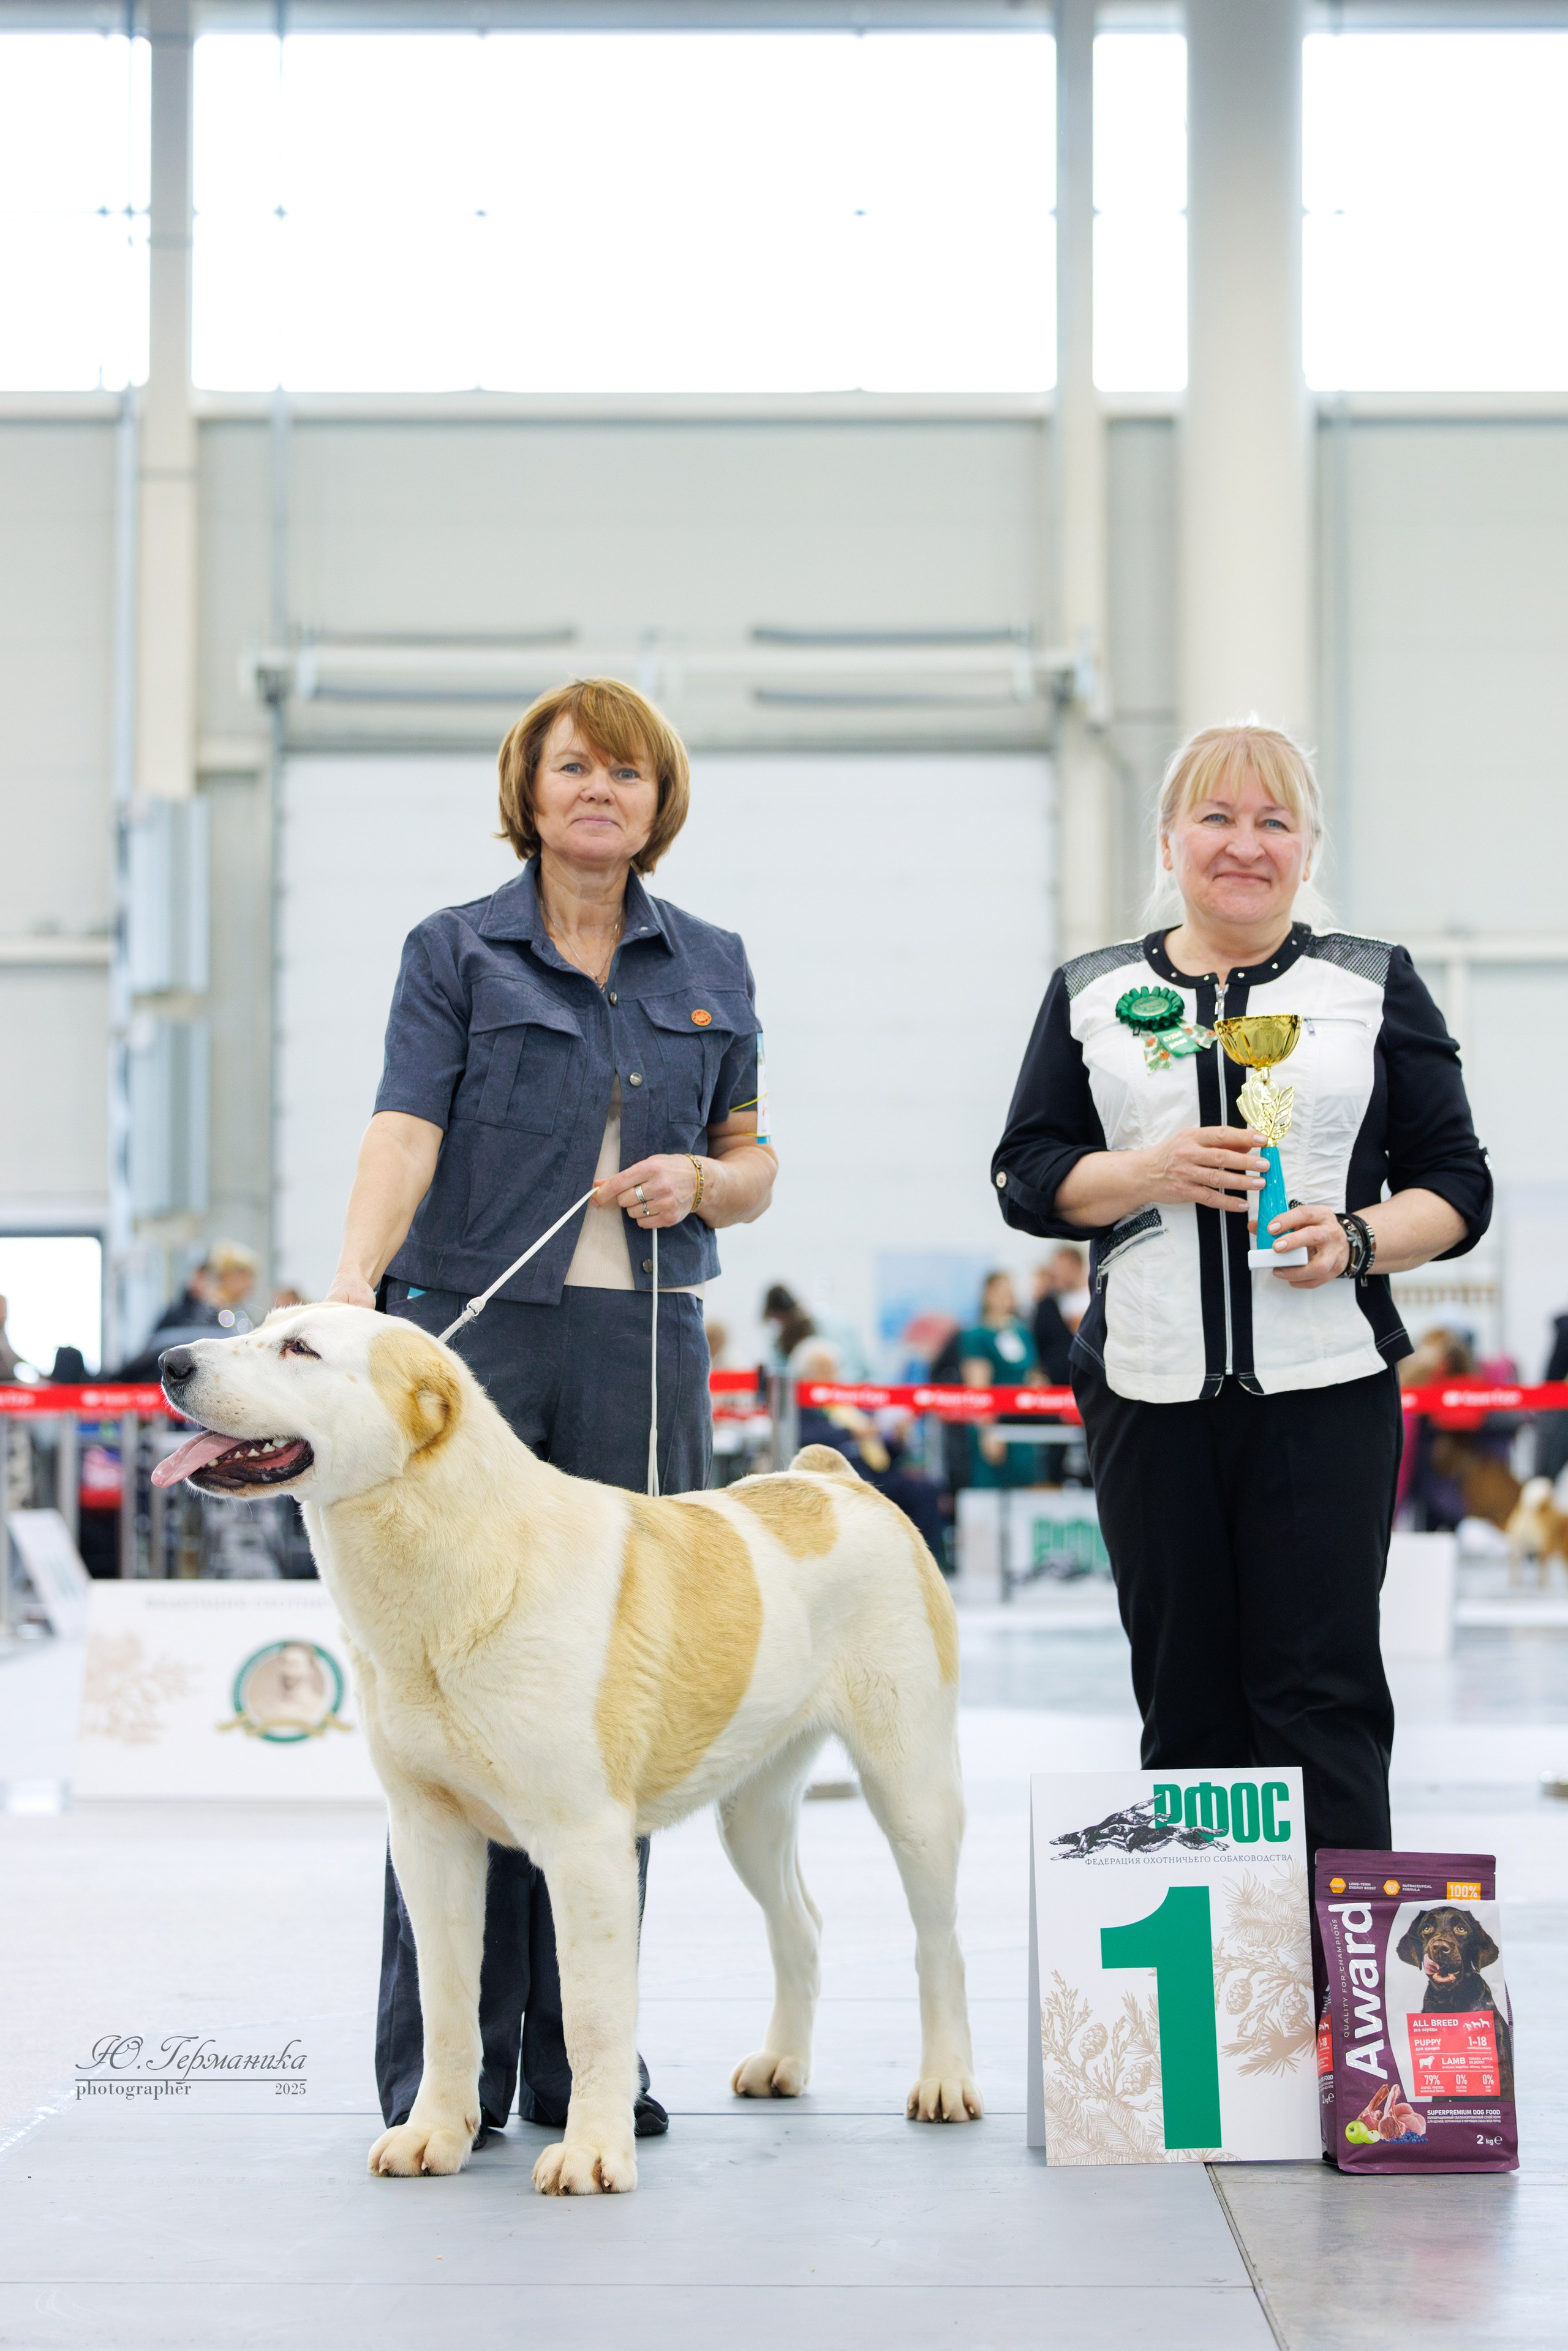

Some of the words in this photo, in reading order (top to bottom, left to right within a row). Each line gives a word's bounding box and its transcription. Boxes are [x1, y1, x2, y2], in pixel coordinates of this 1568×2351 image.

[1153, 1782, 1291, 1843] РФОС
[1085, 1857, 1141, 1866] ФЕДЕРАЦИЯ
[1144, 1855, 1210, 1864] ОХОТНИЧЬЕГО
[1213, 1854, 1293, 1863] СОБАКОВОДСТВА
[1450, 1884, 1478, 1898] 100%
[1333, 1919, 1344, 1972] CHAMPIONS
[1327, 1902, 1388, 2080] Award
[1100, 1886, 1222, 2149] 1
[1468, 2036, 1487, 2047] 1-18
[1424, 2075, 1441, 2085] 79%
[1455, 2074, 1468, 2085] 0%
[1482, 2074, 1494, 2085] 0%
[1477, 2134, 1483, 2144] 2
